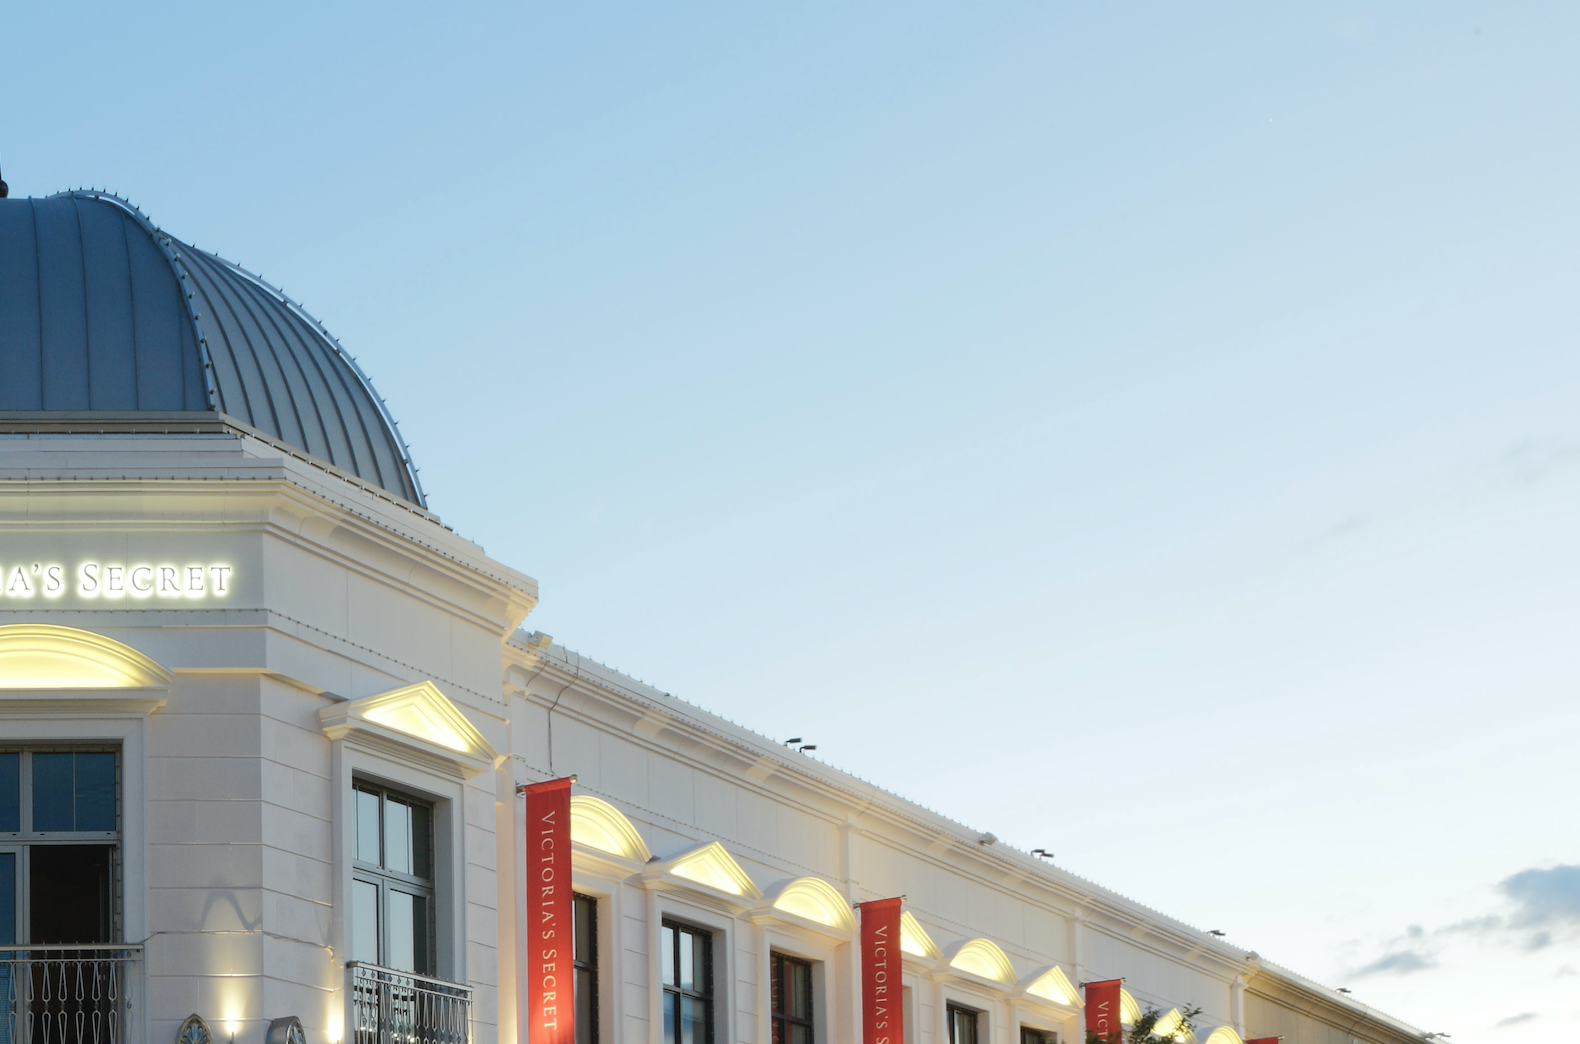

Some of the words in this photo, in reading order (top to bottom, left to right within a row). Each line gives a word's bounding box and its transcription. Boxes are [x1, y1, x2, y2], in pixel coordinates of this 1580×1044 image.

[82, 562, 232, 593] SECRET
[541, 810, 556, 940] VICTORIA'S
[542, 948, 558, 1031] SECRET
[874, 925, 889, 1030] VICTORIA'S
